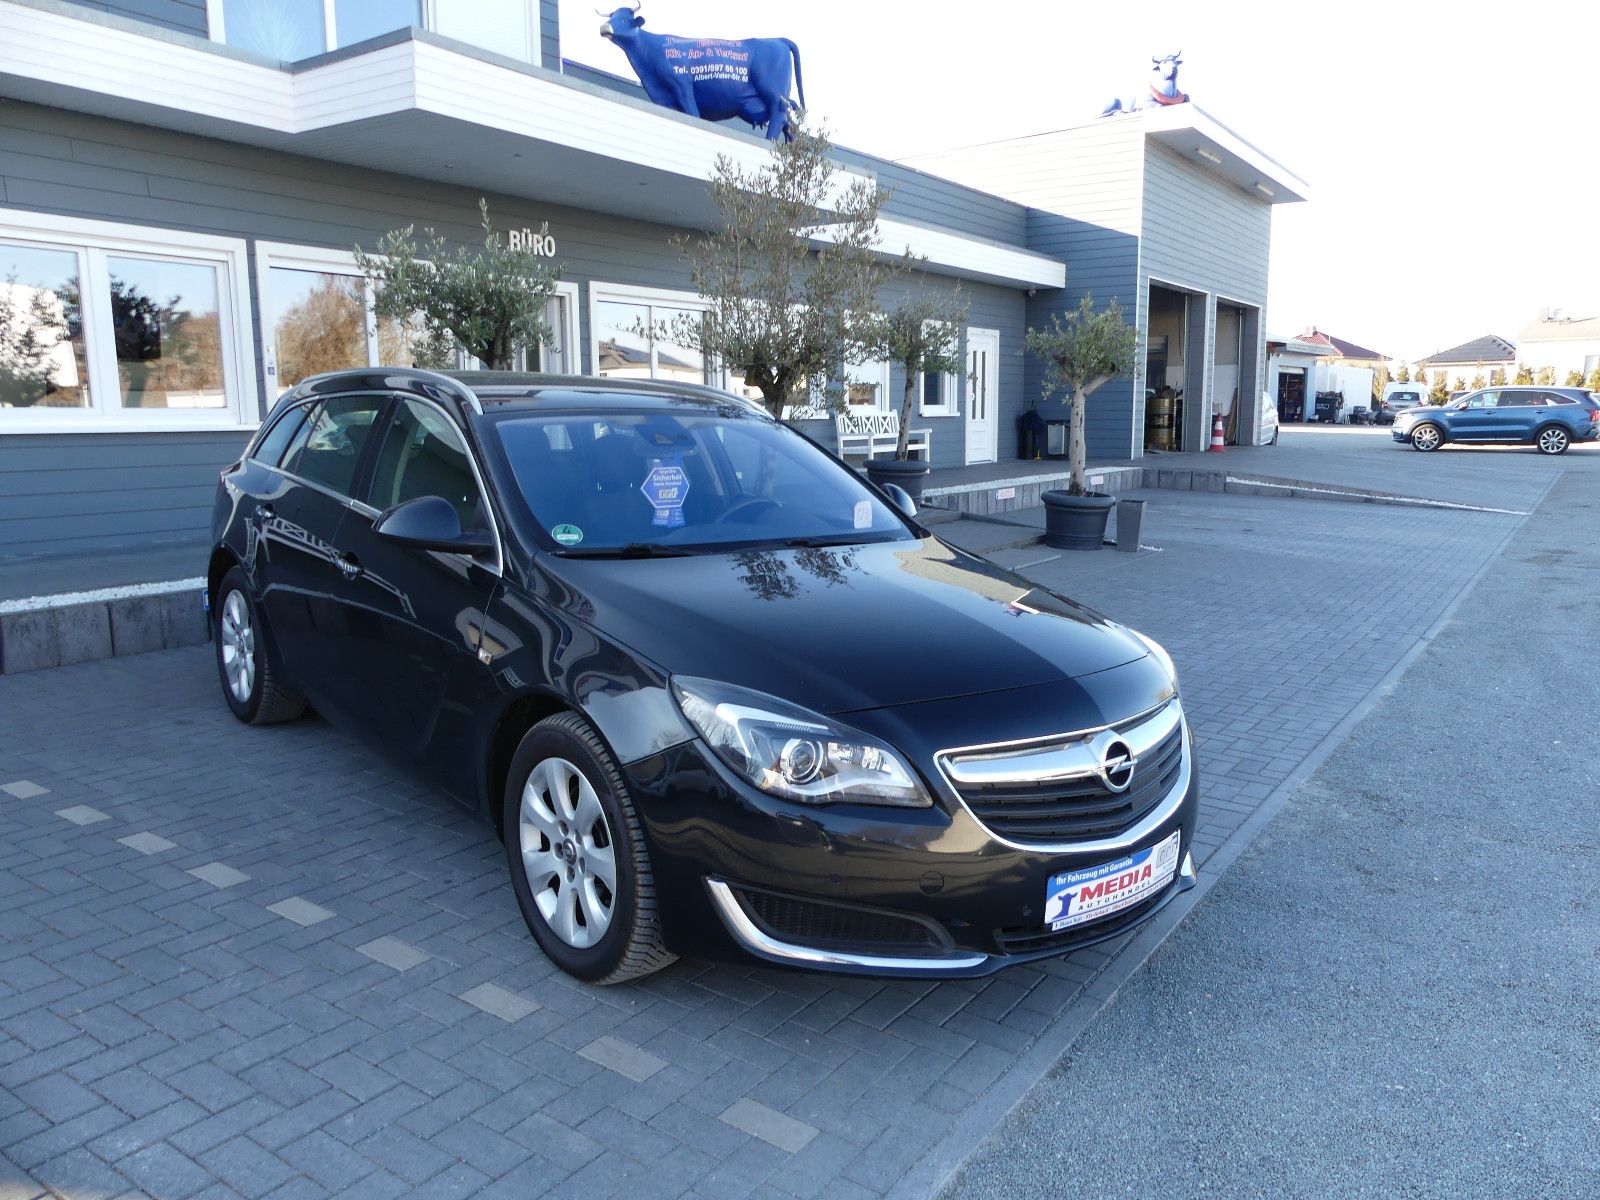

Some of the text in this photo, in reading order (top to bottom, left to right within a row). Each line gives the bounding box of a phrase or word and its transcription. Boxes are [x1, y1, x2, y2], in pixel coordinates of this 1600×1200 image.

[673, 66, 689, 74] Tel.
[736, 66, 748, 76] 100
[509, 227, 556, 258] BÜRO
[1056, 858, 1134, 886] Ihr Fahrzeug mit Garantie
[1080, 863, 1152, 903] MEDIA
[1078, 879, 1151, 911] AUTOHANDEL
